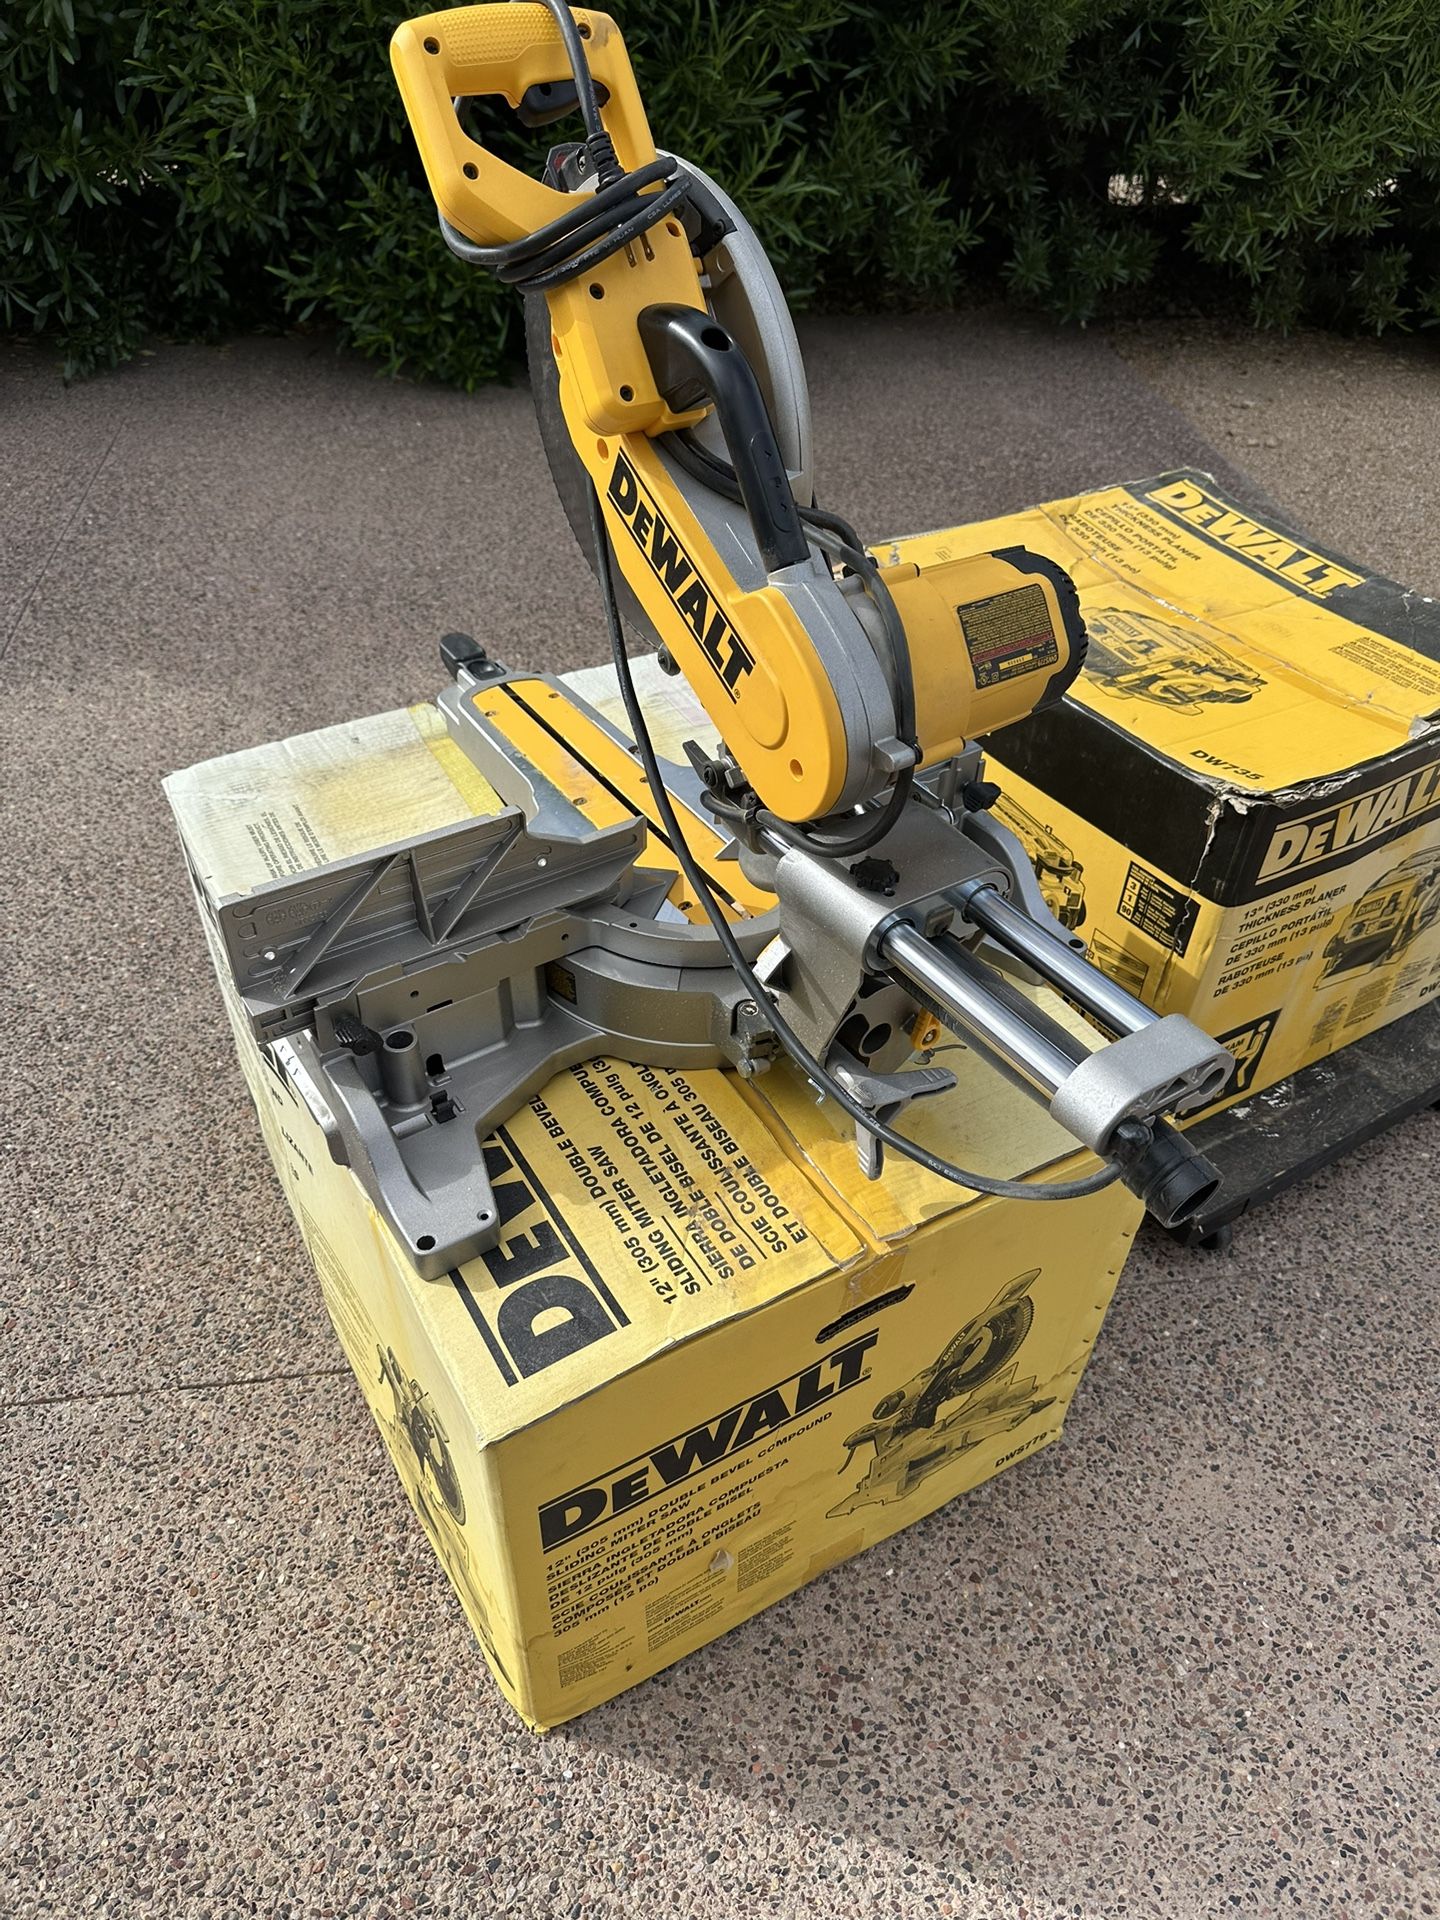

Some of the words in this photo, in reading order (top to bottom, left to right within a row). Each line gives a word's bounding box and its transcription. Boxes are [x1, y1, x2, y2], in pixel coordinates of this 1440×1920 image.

[1067, 514, 1123, 551] RABOTEUSE
[1084, 510, 1097, 519] DE
[1098, 519, 1117, 533] 330
[1116, 533, 1134, 545] mm
[1133, 544, 1151, 556] (13
[1149, 555, 1177, 571] pulg)
[1095, 508, 1133, 533] CEPILLO
[1111, 504, 1162, 537] THICKNESS
[1162, 537, 1201, 561] PLANER
[1160, 526, 1181, 539] mm)
[1071, 527, 1090, 540] 330
[1105, 552, 1124, 563] (13
[1121, 563, 1141, 574] po)
[1190, 750, 1265, 781] DW735
[1130, 882, 1137, 890] 3
[1244, 905, 1263, 920] 13"
[1264, 895, 1290, 913] (330
[1292, 885, 1316, 901] mm)
[1121, 904, 1132, 916] 90
[1238, 902, 1301, 933] THICKNESS
[1303, 885, 1347, 908] PLANER
[1225, 955, 1241, 967] DE
[1244, 945, 1265, 959] 330
[1267, 936, 1287, 950] mm
[1289, 927, 1307, 942] (13
[1230, 927, 1277, 953] CEPILLO
[1213, 985, 1229, 998] DE
[1231, 976, 1252, 990] 330
[1254, 967, 1274, 981] mm
[1276, 958, 1294, 972] (13
[1218, 952, 1285, 985] RABOTEUSE
[605, 1073, 634, 1101] pulg
[662, 1100, 681, 1114] À
[670, 1077, 697, 1102] 305
[528, 1094, 565, 1139] BEVEL
[625, 1102, 645, 1120] 12
[691, 1103, 739, 1155] BISEAU
[639, 1121, 663, 1144] DE
[557, 1139, 606, 1199] DOUBLE
[586, 1145, 619, 1177] SAW
[610, 1117, 687, 1219] INGLETADORA
[658, 1143, 695, 1189] BISEL
[673, 1113, 756, 1214] COULISSANTE
[612, 1178, 654, 1229] MITER
[732, 1155, 789, 1219] DOUBLE
[599, 1200, 631, 1233] mm)
[688, 1189, 736, 1243] DOBLE
[751, 1215, 788, 1253] SCIE
[782, 1221, 809, 1244] ET
[481, 1132, 618, 1380] DEW
[624, 1237, 660, 1273] (305
[648, 1229, 700, 1295] SLIDING
[685, 1219, 735, 1279] SIERRA
[730, 1243, 756, 1270] DE
[649, 1278, 677, 1304] 12"
[995, 1432, 1048, 1468] DWS779
[547, 1555, 571, 1571] 12"
[576, 1535, 608, 1557] (305
[614, 1517, 643, 1537] mm)
[648, 1483, 706, 1518] DOUBLE
[710, 1459, 753, 1485] BEVEL
[757, 1411, 832, 1458] COMPOUND
[546, 1546, 605, 1580] SLIDING
[611, 1518, 656, 1548] MITER
[660, 1500, 690, 1520] SAW
[548, 1563, 601, 1594] SIERRA
[606, 1506, 704, 1562] INGLETADORA
[708, 1458, 789, 1506] COMPUESTA
[549, 1550, 638, 1602] DESLIZANTE
[643, 1537, 662, 1551] DE
[666, 1509, 712, 1538] DOBLE
[716, 1487, 753, 1511] BISEL
[636, 1571, 654, 1585] ET
[657, 1539, 711, 1572] DOUBLE
[715, 1508, 761, 1540] BISEAU
[550, 1596, 570, 1610] DE
[576, 1583, 593, 1596] 12
[597, 1566, 627, 1586] pulg
[631, 1546, 660, 1566] (305
[665, 1528, 693, 1547] mm)
[552, 1600, 585, 1622] SCIE
[589, 1545, 684, 1601] COULISSANTE
[701, 1501, 761, 1539] ONGLETS
[554, 1620, 580, 1638] 305
[585, 1605, 610, 1622] mm
[614, 1590, 635, 1606] (12
[639, 1576, 659, 1593] po)
